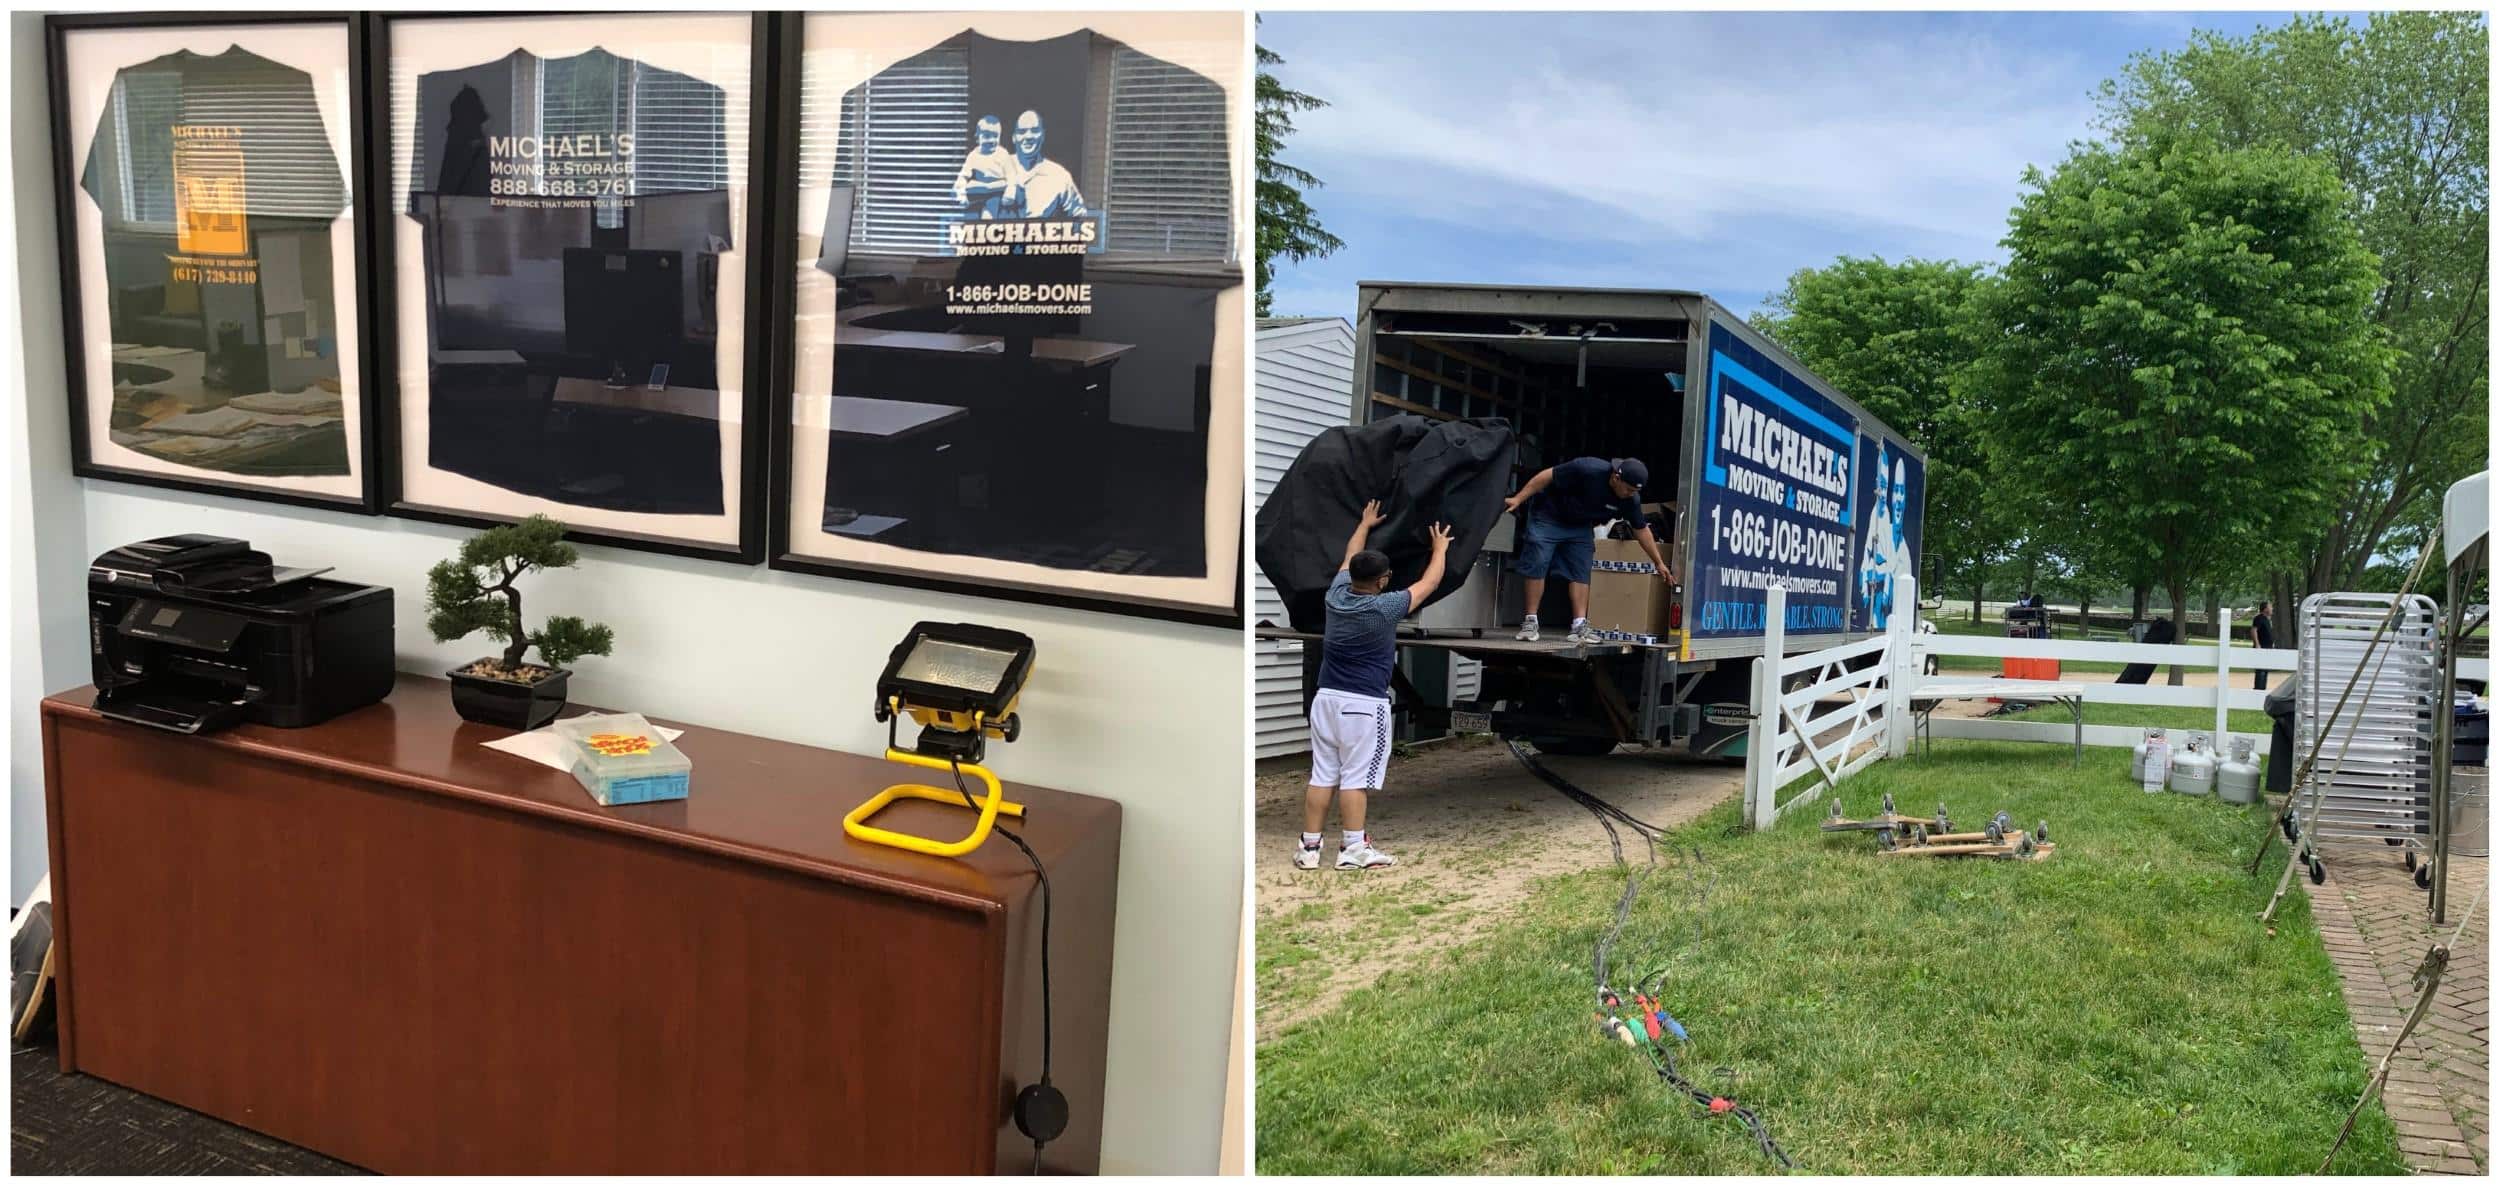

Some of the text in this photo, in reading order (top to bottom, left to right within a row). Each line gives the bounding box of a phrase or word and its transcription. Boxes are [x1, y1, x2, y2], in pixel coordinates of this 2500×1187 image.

[490, 134, 635, 158] MICHAEL'S
[490, 162, 634, 176] MOVING & STORAGE
[490, 197, 539, 208] EXPERIENCE
[542, 200, 561, 208] THAT
[563, 200, 590, 208] MOVES
[593, 199, 609, 208] YOU
[956, 245, 1010, 256] MOVING
[1025, 244, 1086, 255] STORAGE
[946, 284, 1092, 302] 1-866-JOB-DONE
[946, 303, 1092, 315] www.michaelsmovers.com
[1728, 463, 1840, 523] MOVING & STORAGE
[1712, 504, 1845, 571] 1-866-JOB-DONE
[1759, 604, 1810, 631] RABLE.
